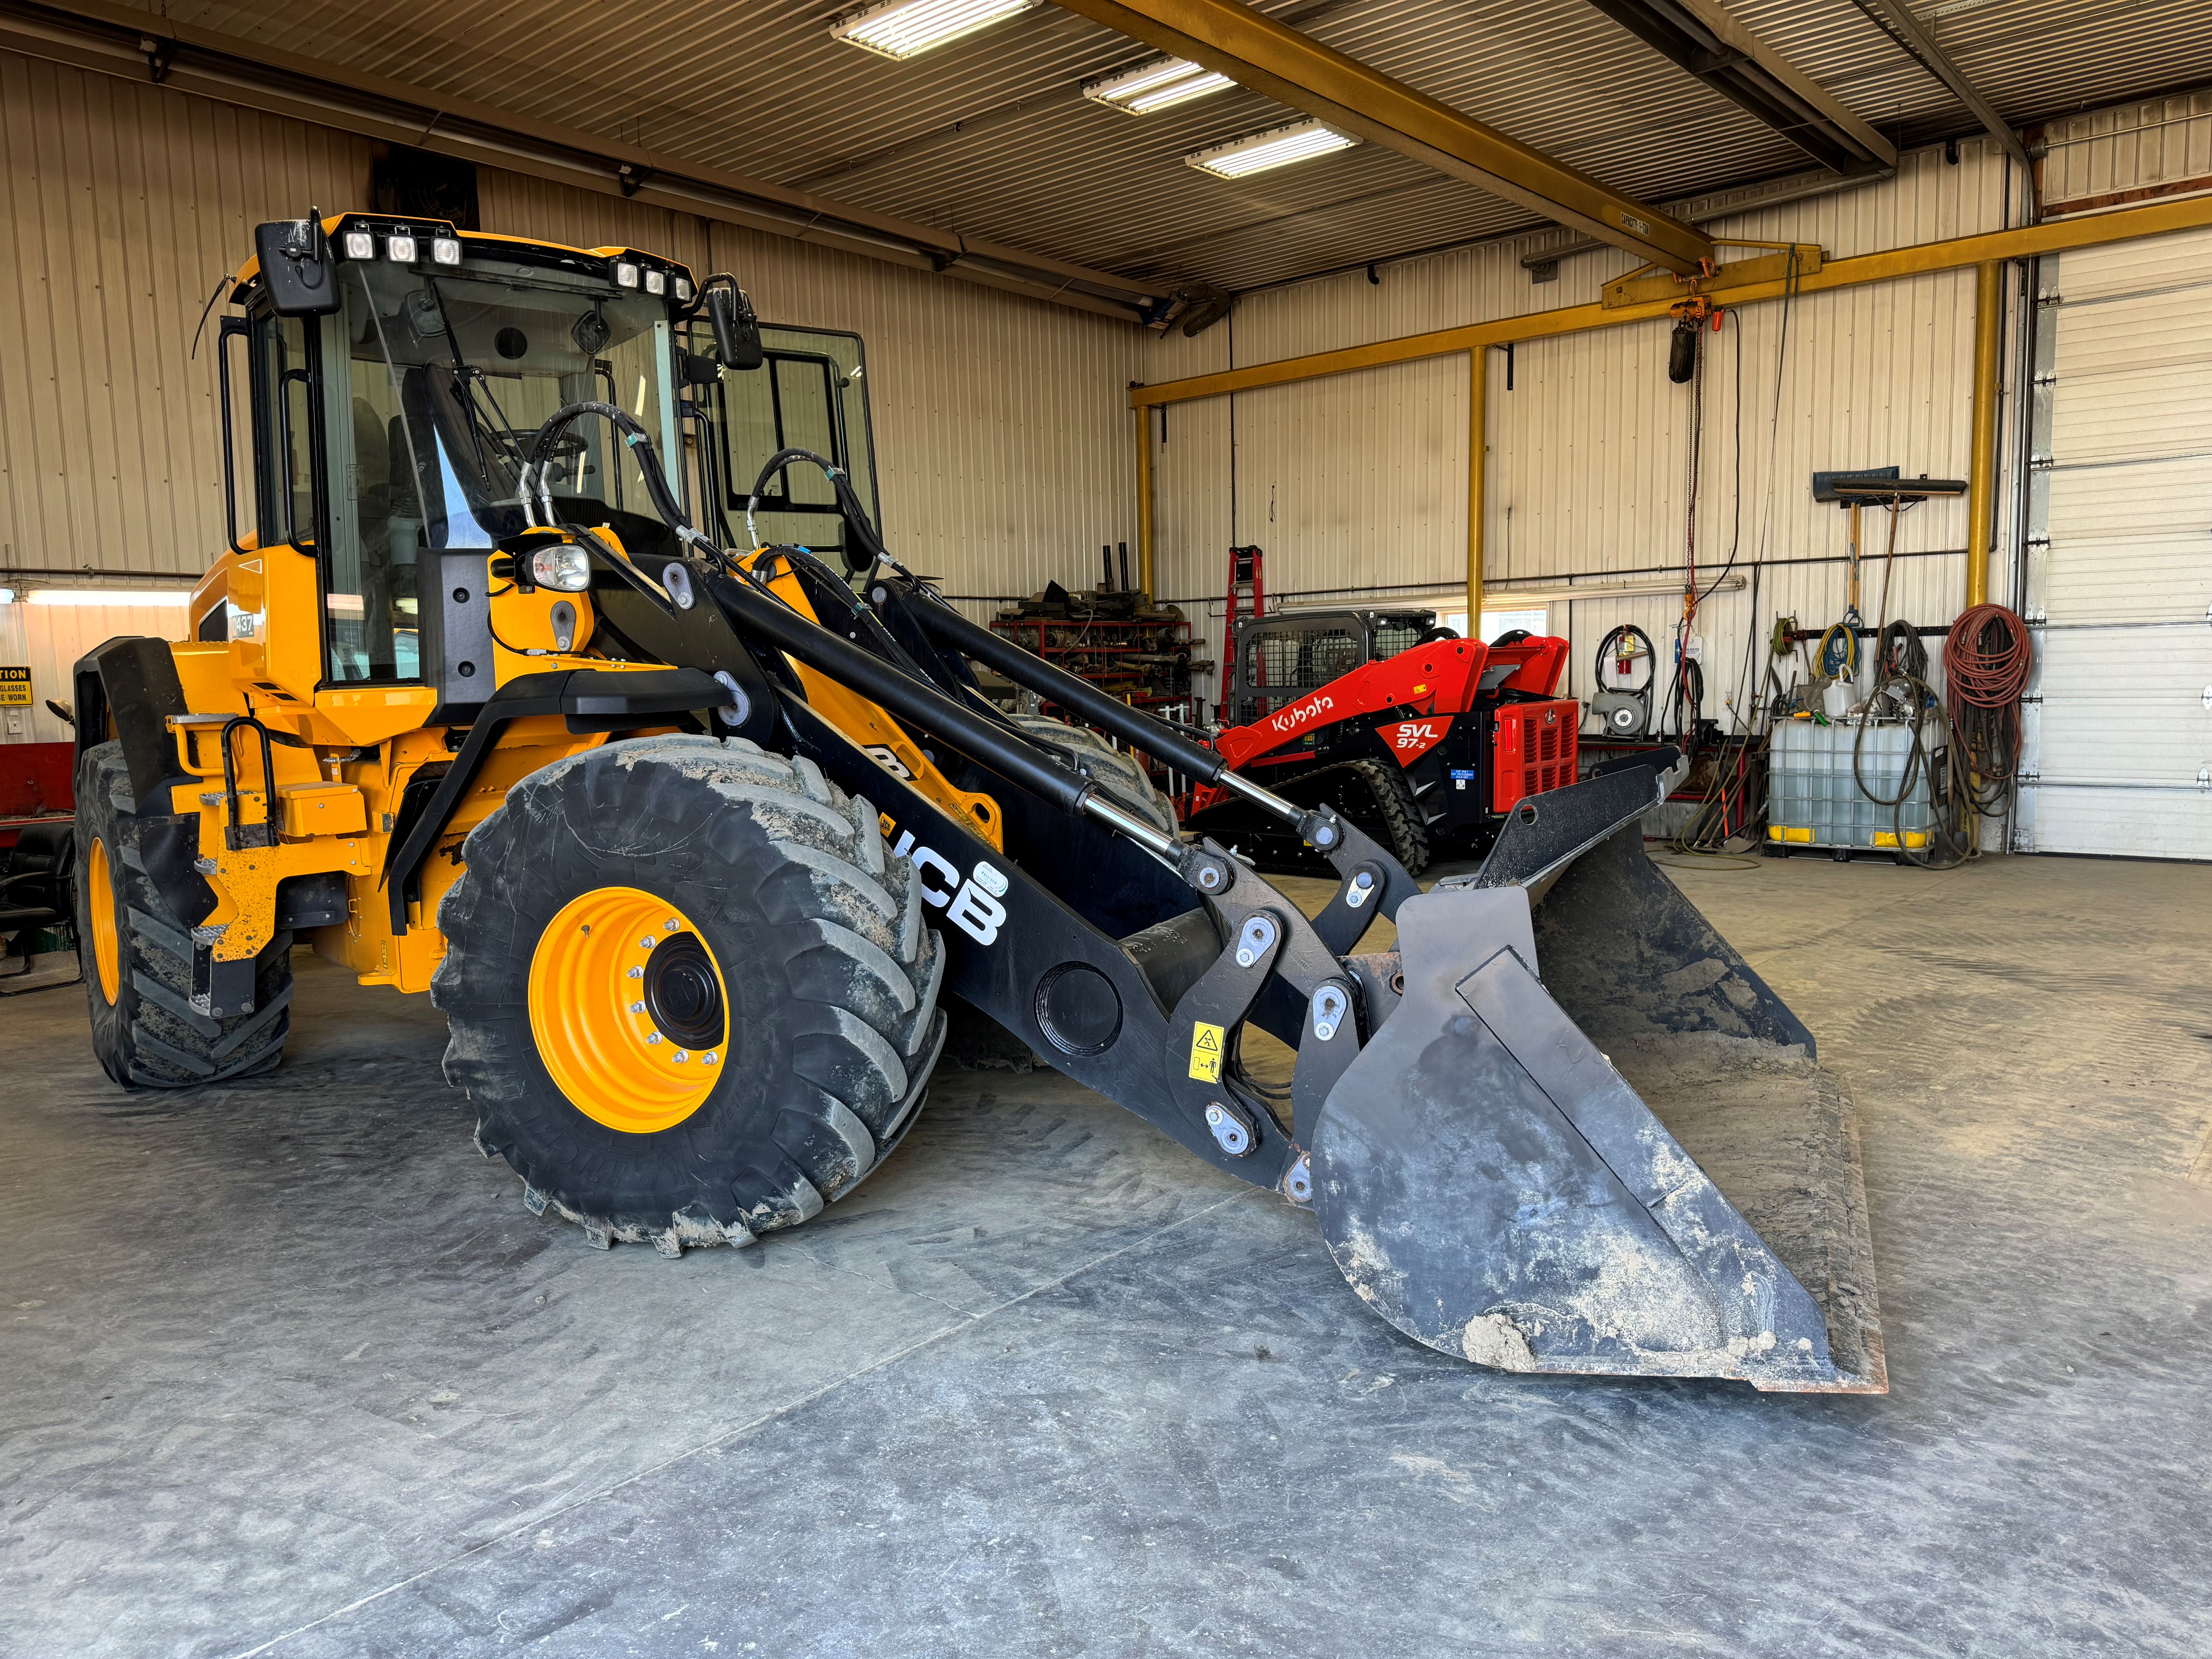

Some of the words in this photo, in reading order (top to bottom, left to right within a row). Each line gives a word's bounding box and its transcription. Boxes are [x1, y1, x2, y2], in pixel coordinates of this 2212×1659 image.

[1621, 213, 1638, 230] CAPACITY:
[1639, 221, 1649, 235] 1-TON
[237, 615, 252, 632] 437
[1272, 696, 1334, 731] Kubota
[1396, 724, 1438, 738] SVL
[1396, 738, 1426, 749] 97-2
[881, 819, 891, 830] JCB
